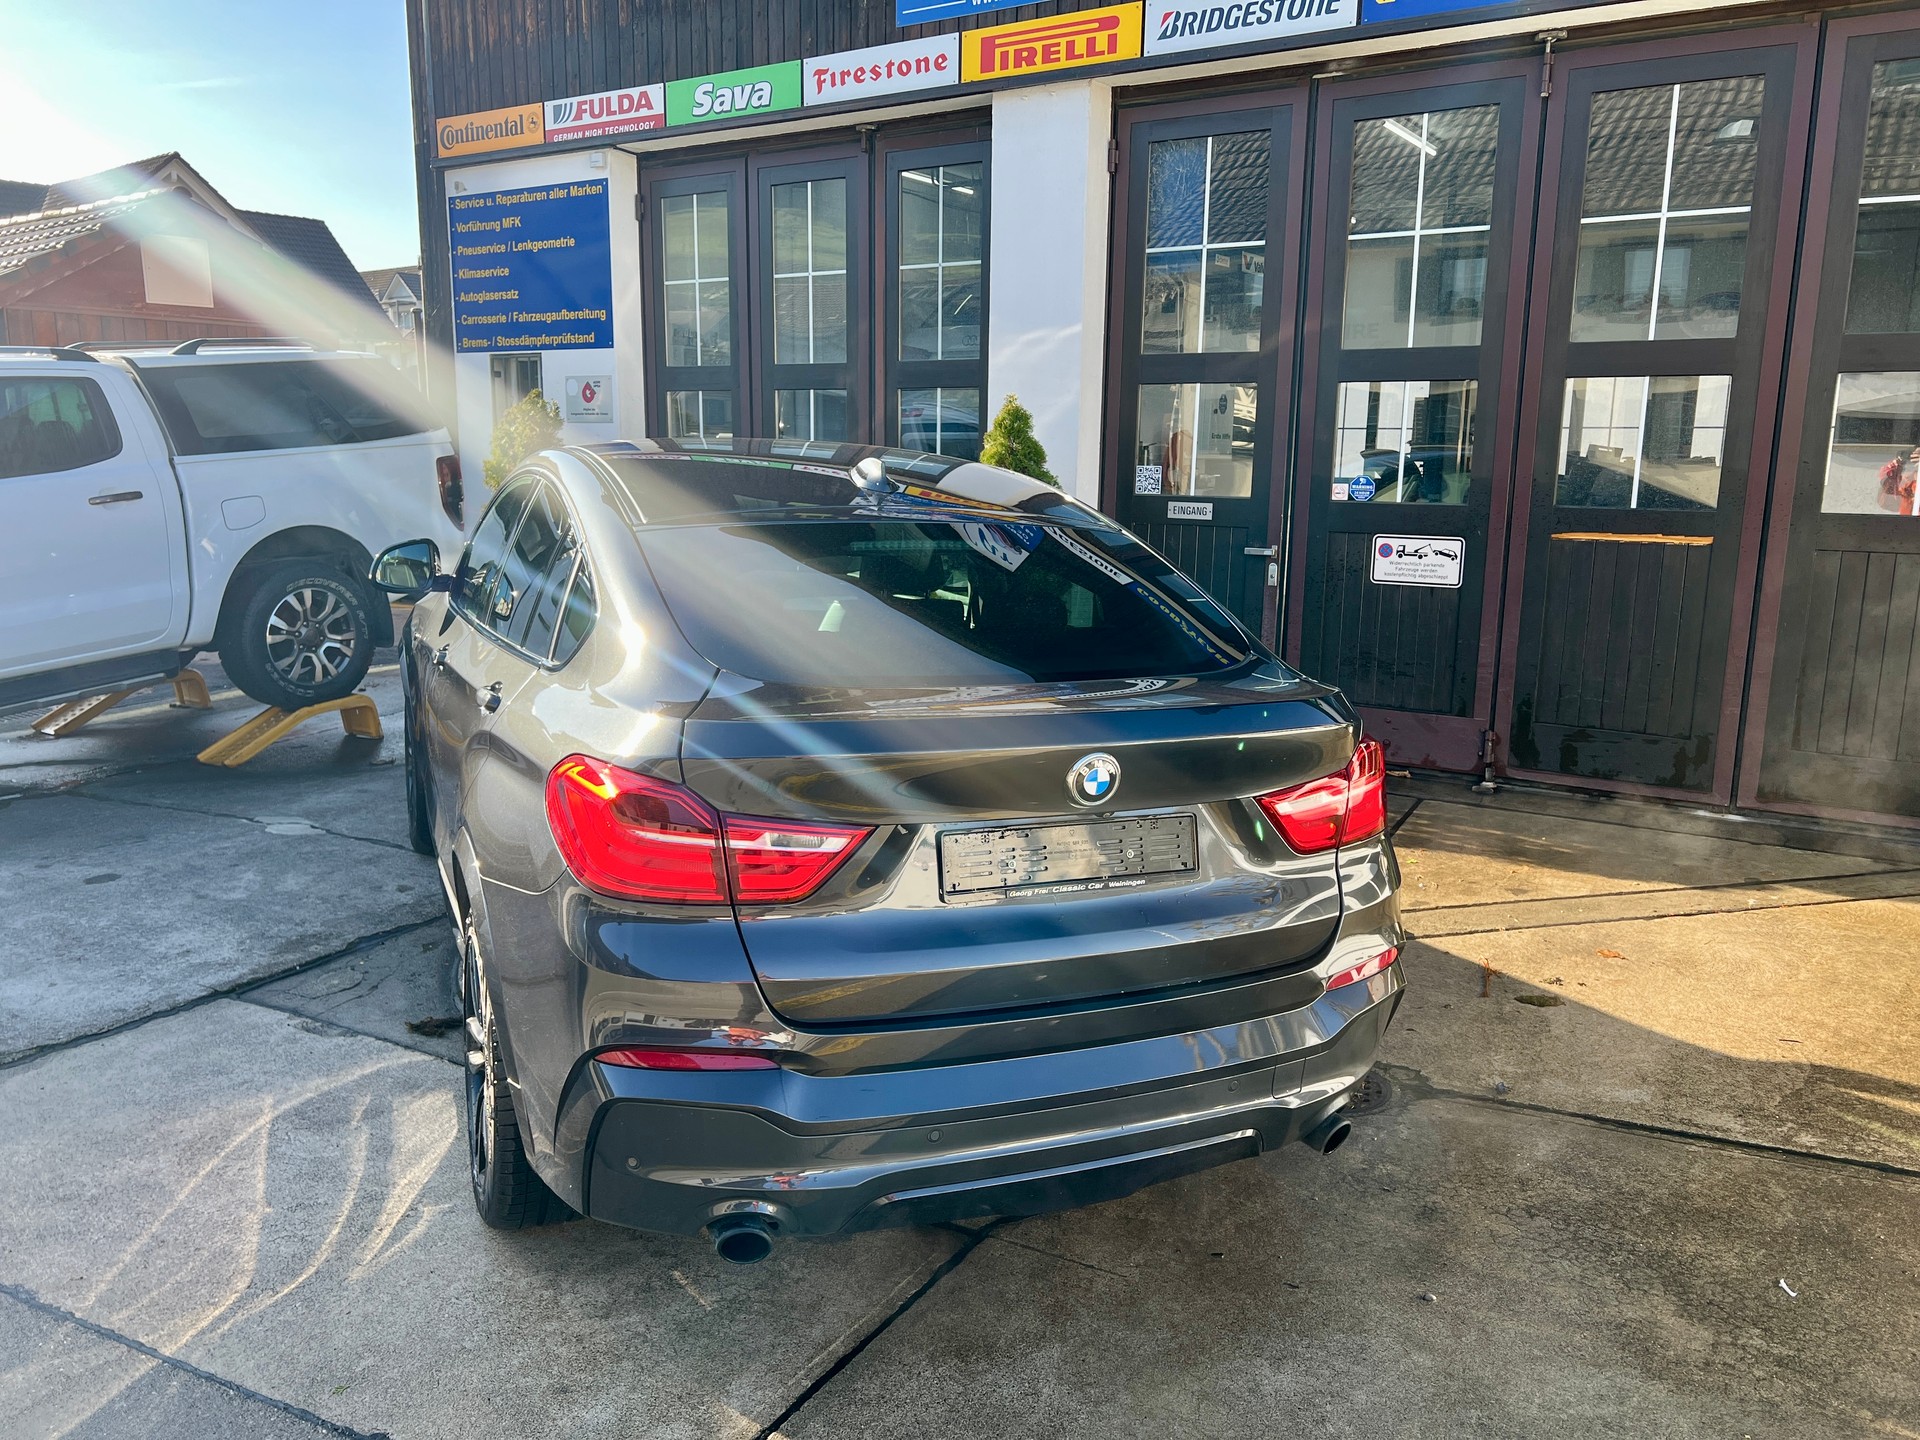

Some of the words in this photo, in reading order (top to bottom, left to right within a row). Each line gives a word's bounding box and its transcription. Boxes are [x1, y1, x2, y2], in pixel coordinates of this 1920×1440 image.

[1157, 0, 1340, 41] BRIDGESTONE
[980, 15, 1120, 74] PIRELLI
[812, 53, 949, 95] Firestone
[571, 90, 654, 121] FULDA
[692, 81, 772, 117] Sava
[439, 114, 525, 150] Continental
[553, 130, 583, 142] GERMAN
[585, 127, 604, 138] HIGH
[605, 120, 655, 136] TECHNOLOGY
[455, 198, 485, 209] Service
[486, 198, 494, 207] u.
[496, 191, 547, 207] Reparaturen
[549, 188, 568, 199] aller
[570, 184, 603, 197] Marken
[456, 220, 500, 233] Vorführung
[502, 216, 522, 229] MFK
[457, 243, 506, 256] Pneuservice
[512, 235, 575, 253] Lenkgeometrie
[458, 266, 510, 279] Klimaservice
[459, 289, 519, 303] Autoglasersatz
[461, 312, 507, 325] Carrosserie
[513, 308, 606, 324] Fahrzeugaufbereitung
[463, 337, 491, 348] Brems-
[496, 332, 595, 348] Stossdämpferprüfstand
[1173, 505, 1208, 516] EINGANG
[1080, 759, 1116, 776] BMW
[1052, 884, 1086, 893] Classic
